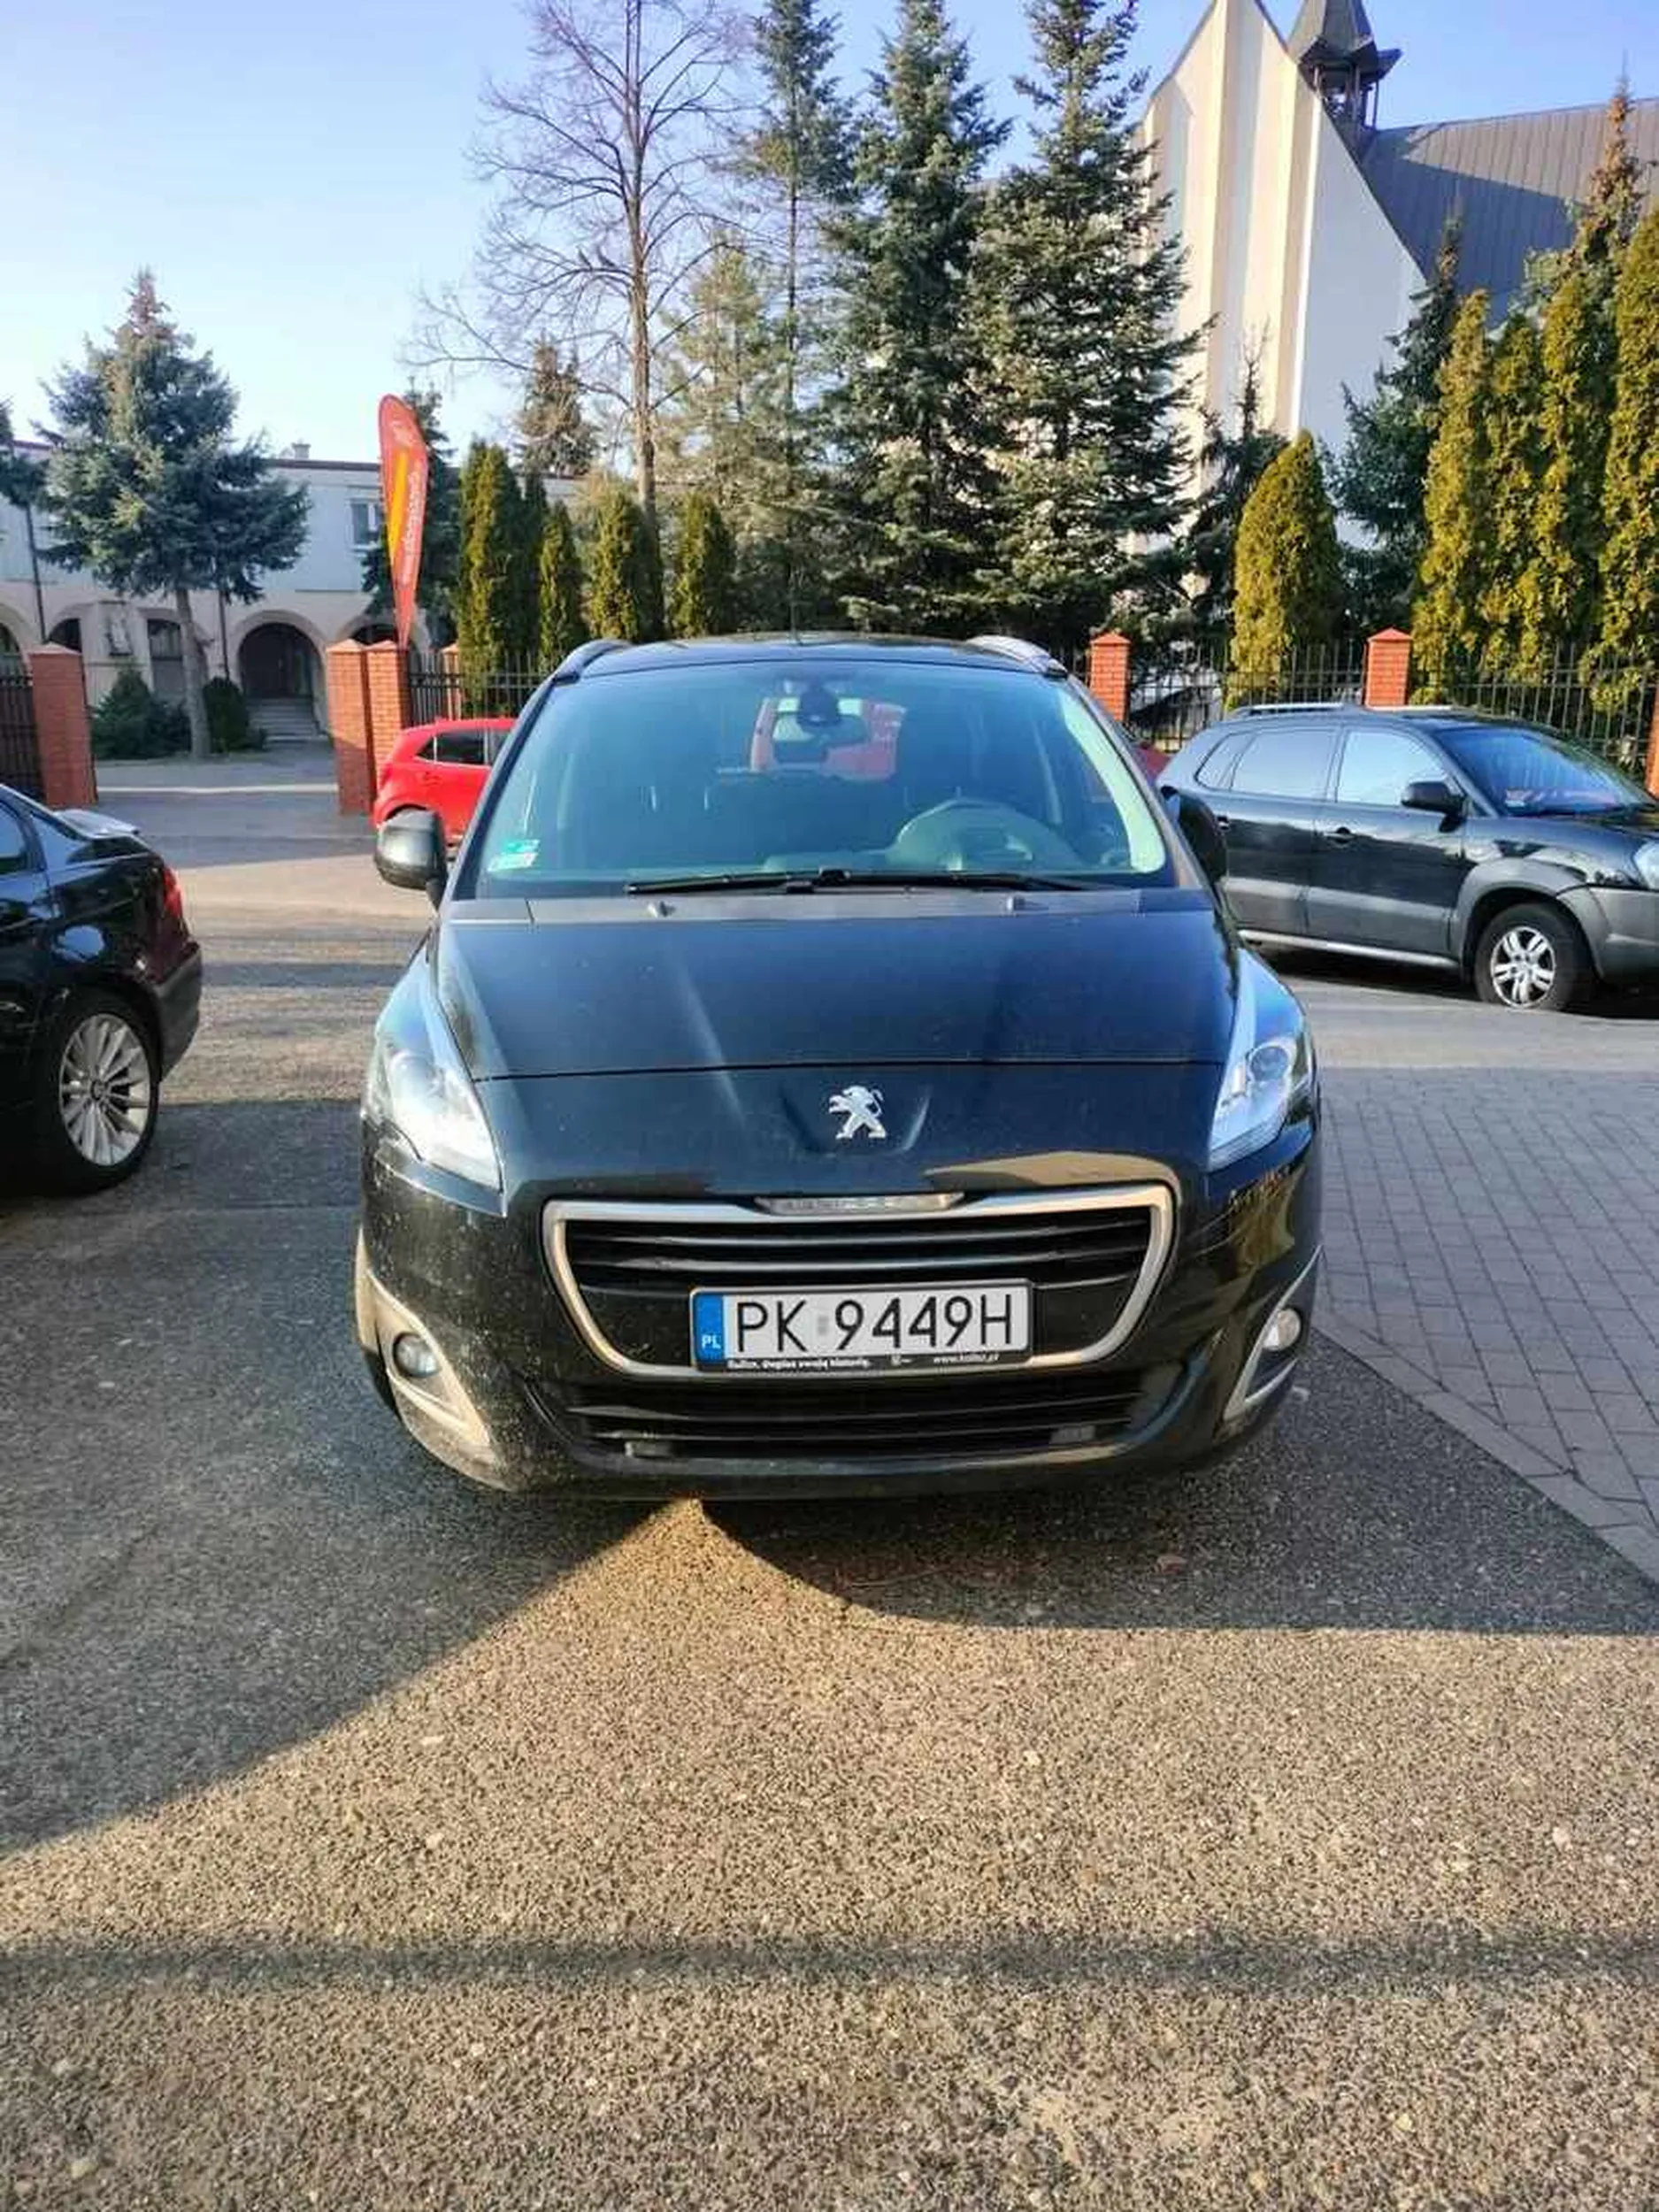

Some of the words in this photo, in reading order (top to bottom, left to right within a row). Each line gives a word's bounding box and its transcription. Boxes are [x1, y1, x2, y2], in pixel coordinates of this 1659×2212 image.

[701, 1335, 721, 1348] PL
[736, 1300, 806, 1353] PK
[834, 1294, 1012, 1350] 9449H
